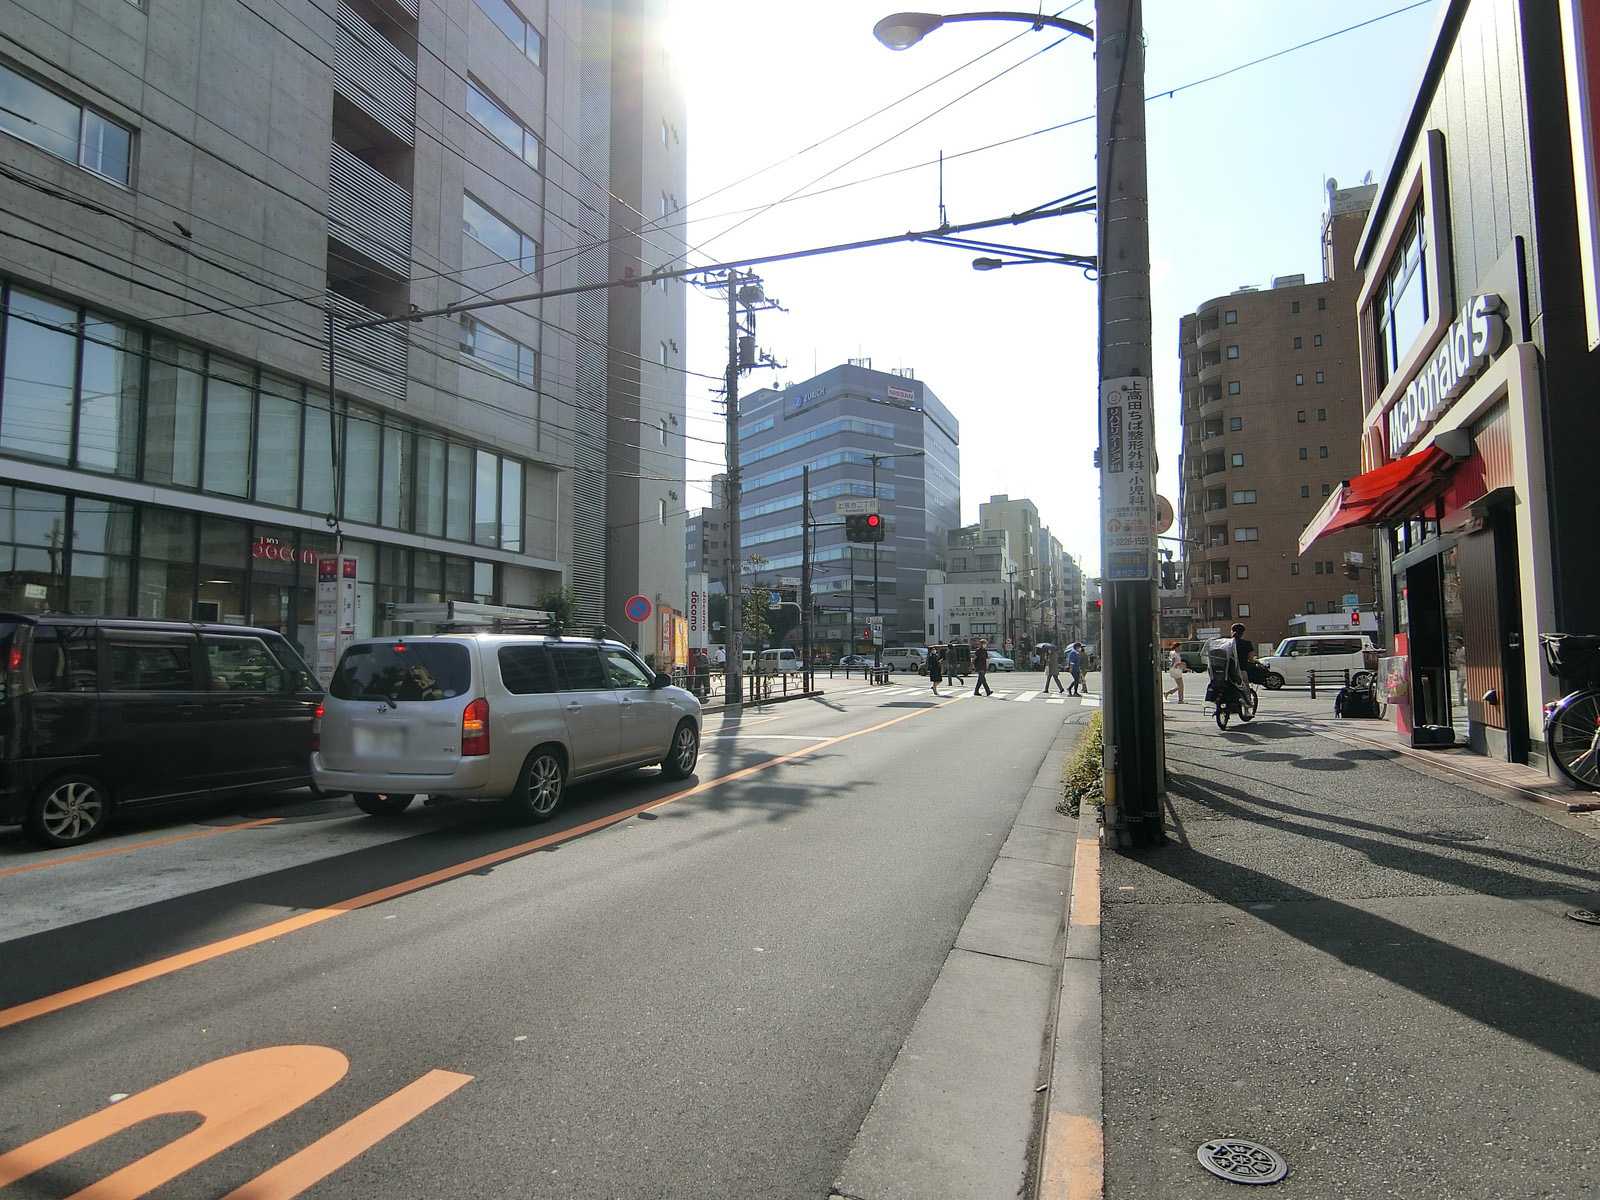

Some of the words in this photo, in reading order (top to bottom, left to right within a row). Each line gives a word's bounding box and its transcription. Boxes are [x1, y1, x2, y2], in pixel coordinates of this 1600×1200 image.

[1389, 295, 1494, 459] McDonald's
[804, 387, 826, 402] ZURICH
[889, 389, 914, 400] NISSAN
[690, 591, 699, 631] docomo
